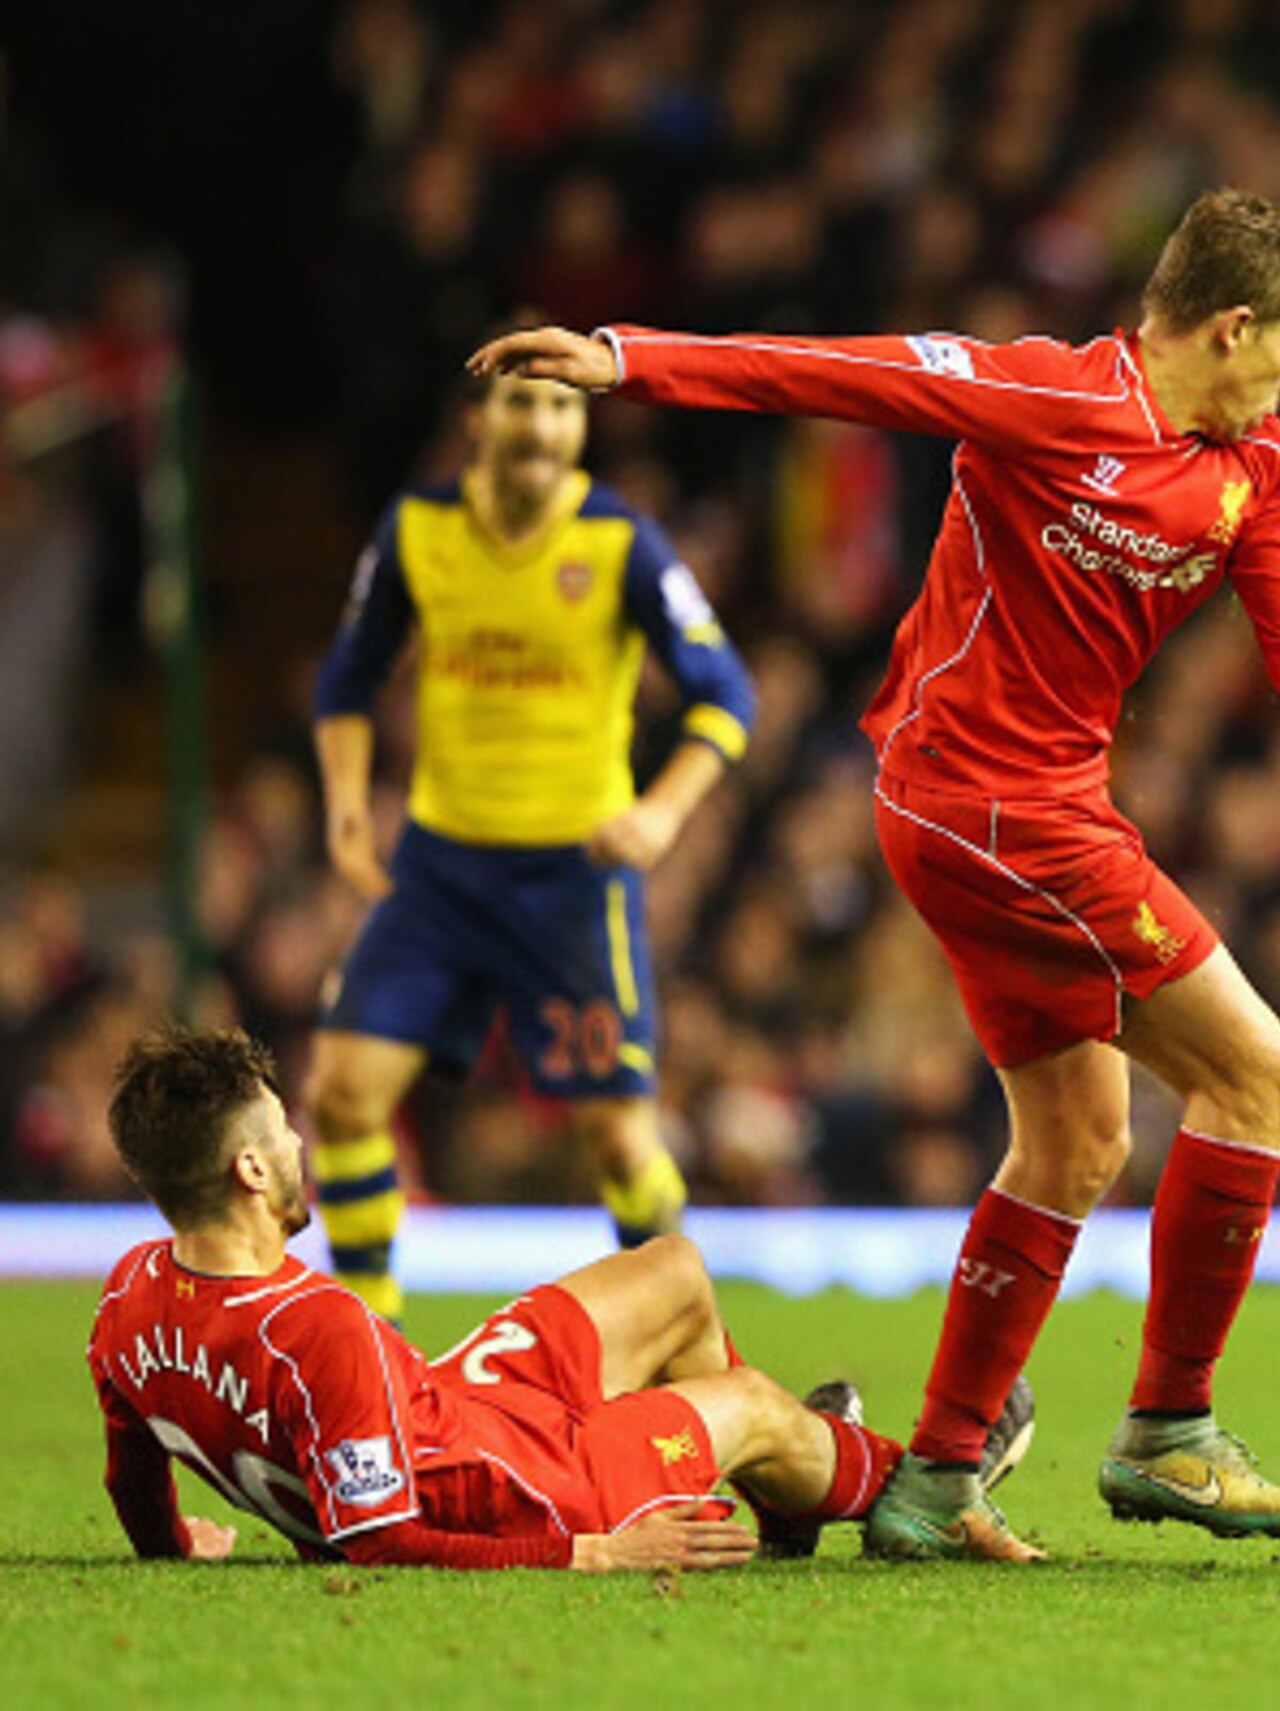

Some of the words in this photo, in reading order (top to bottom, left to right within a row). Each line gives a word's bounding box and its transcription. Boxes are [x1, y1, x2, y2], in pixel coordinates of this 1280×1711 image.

[1068, 501, 1194, 562] Standar
[540, 998, 624, 1079] 20
[118, 1323, 268, 1444] LALLANA
